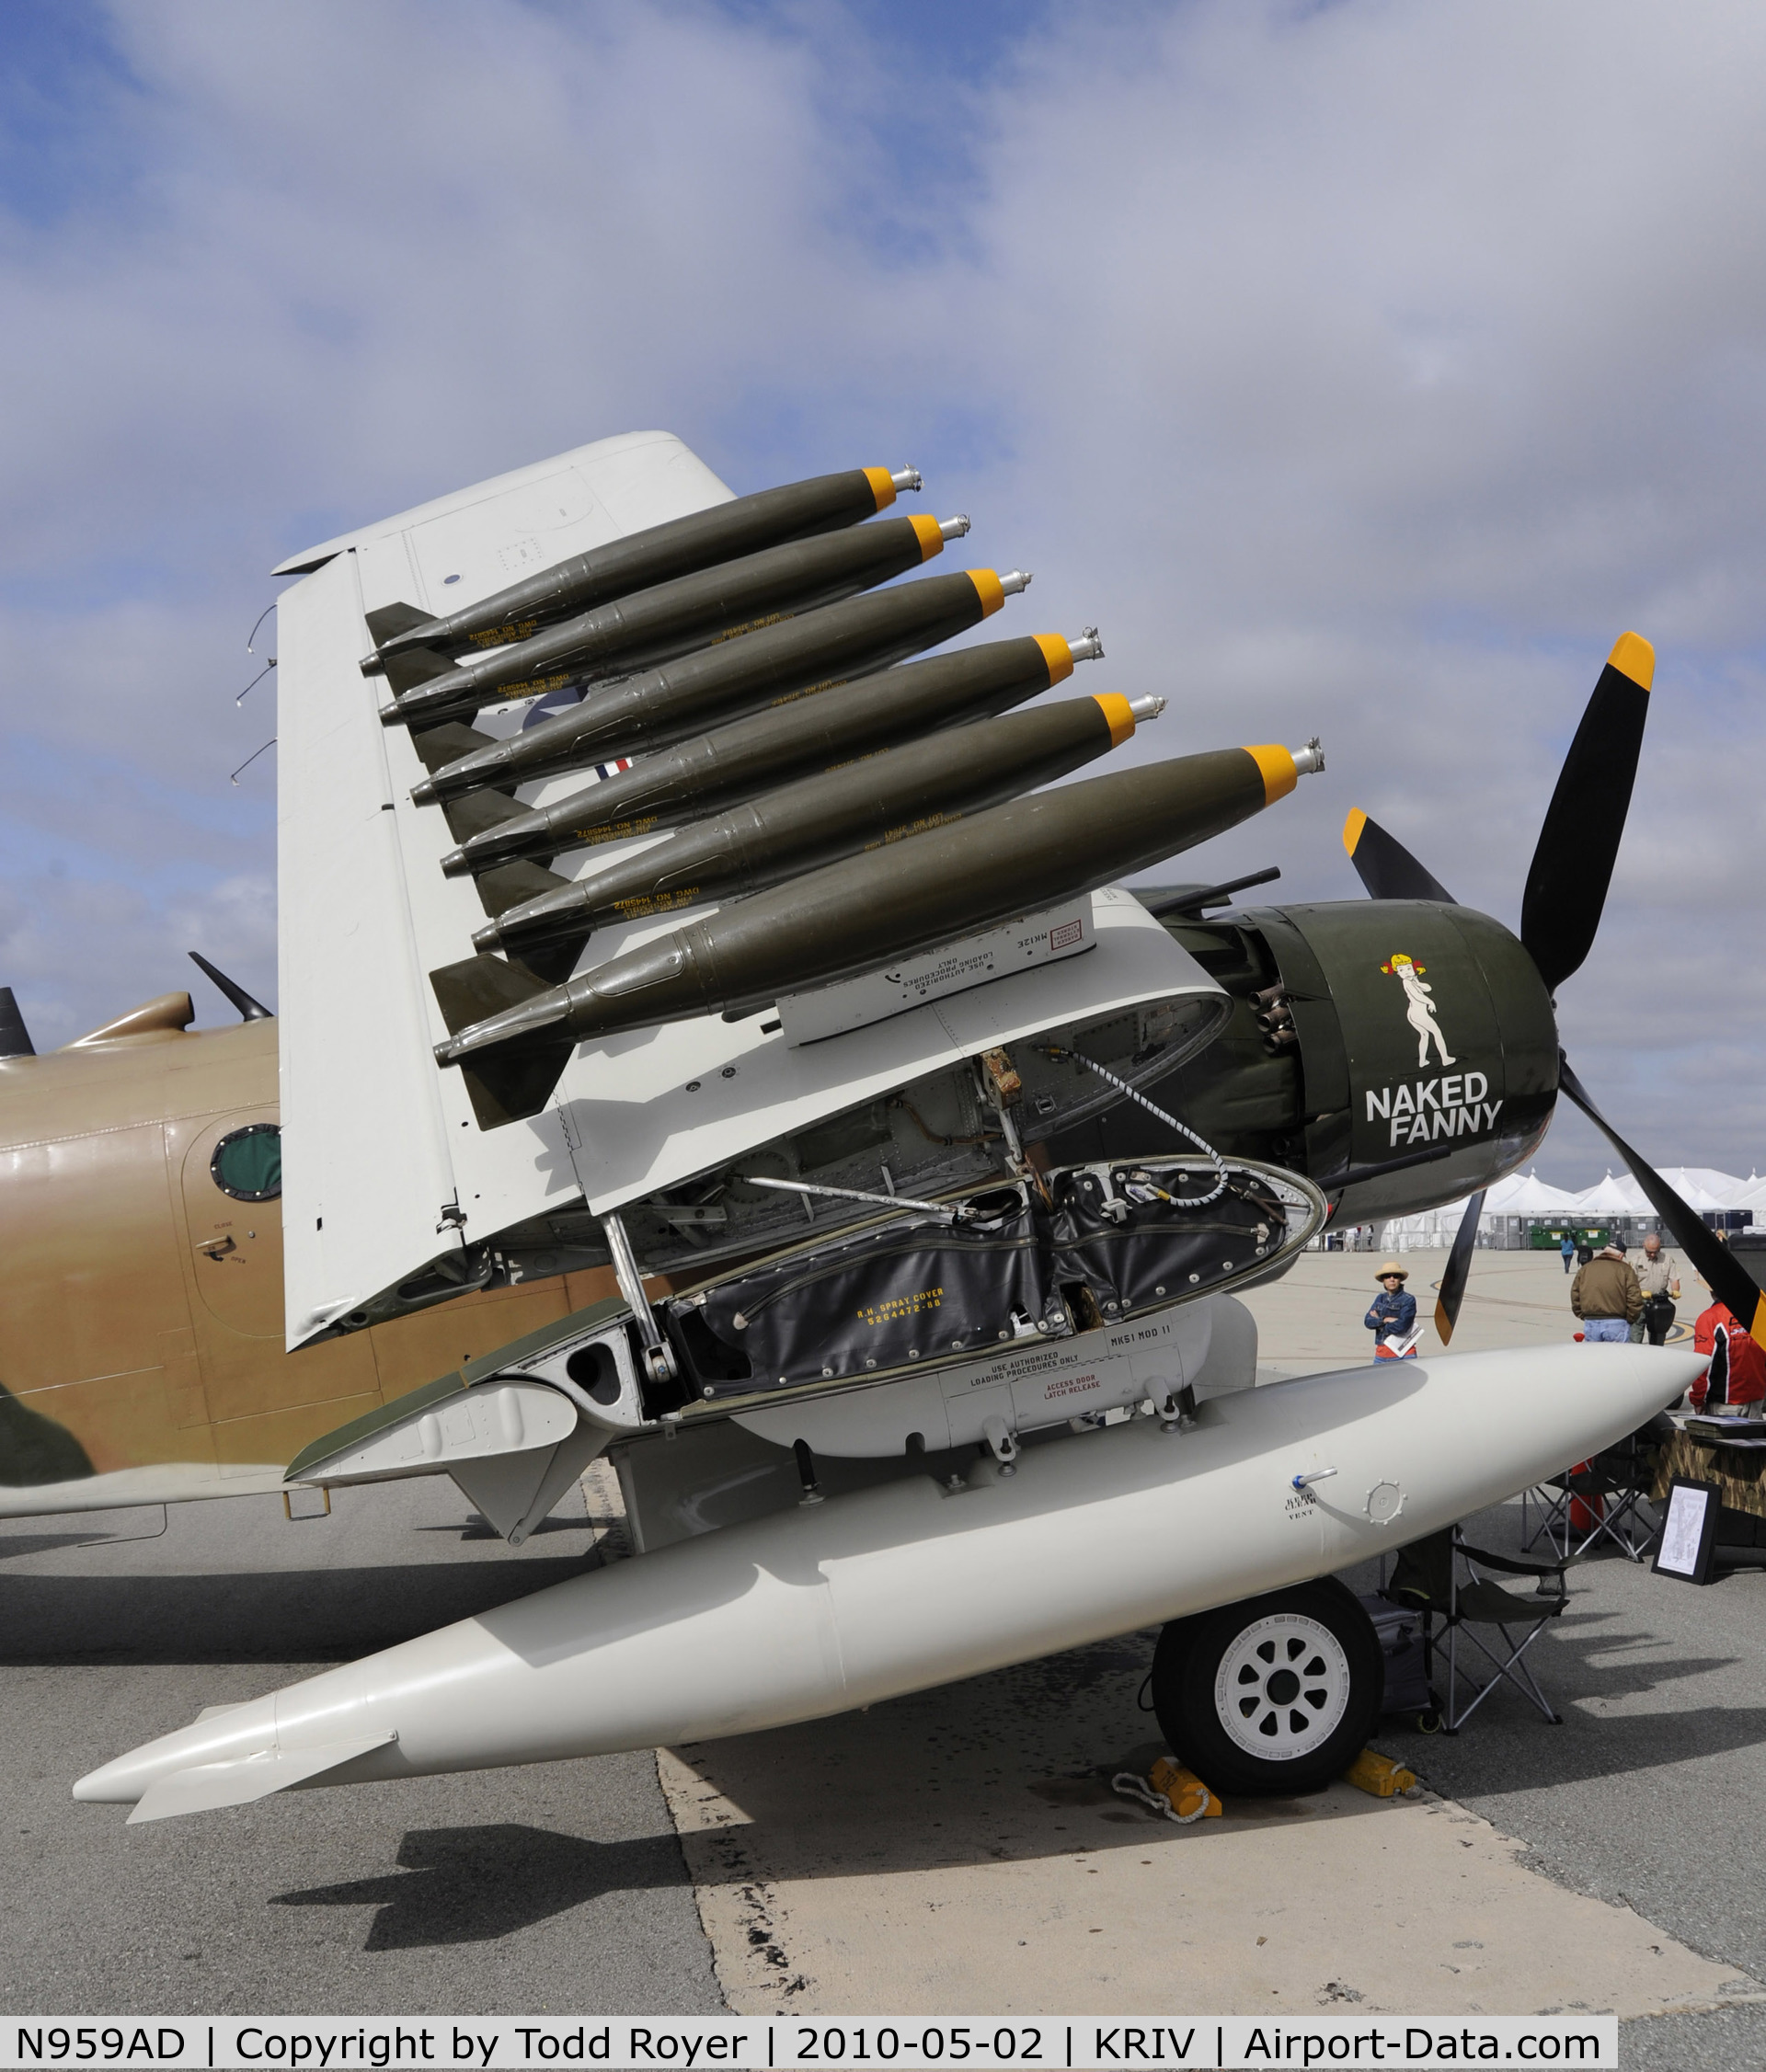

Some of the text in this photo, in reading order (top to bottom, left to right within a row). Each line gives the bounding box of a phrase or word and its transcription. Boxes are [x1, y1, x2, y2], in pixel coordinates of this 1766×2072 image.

[1017, 932, 1048, 948] MK12E
[902, 951, 993, 988] LOADING PROCEDURES
[914, 960, 985, 990] USE AUTHORIZED
[937, 957, 958, 969] ONLY
[1366, 1071, 1488, 1122] NAKED
[1390, 1100, 1503, 1147] FANNY
[856, 1287, 944, 1319] R.H. SPRAY COVER
[1111, 1334, 1136, 1346] MK51
[1139, 1328, 1158, 1341] MOD
[970, 1354, 1079, 1387] LOADING PROCEDURES ONLY
[992, 1351, 1059, 1373] USE AUTHORIZED
[1044, 1380, 1101, 1400] LATCH RELEASE
[1047, 1374, 1095, 1391] ACCESS DOOR
